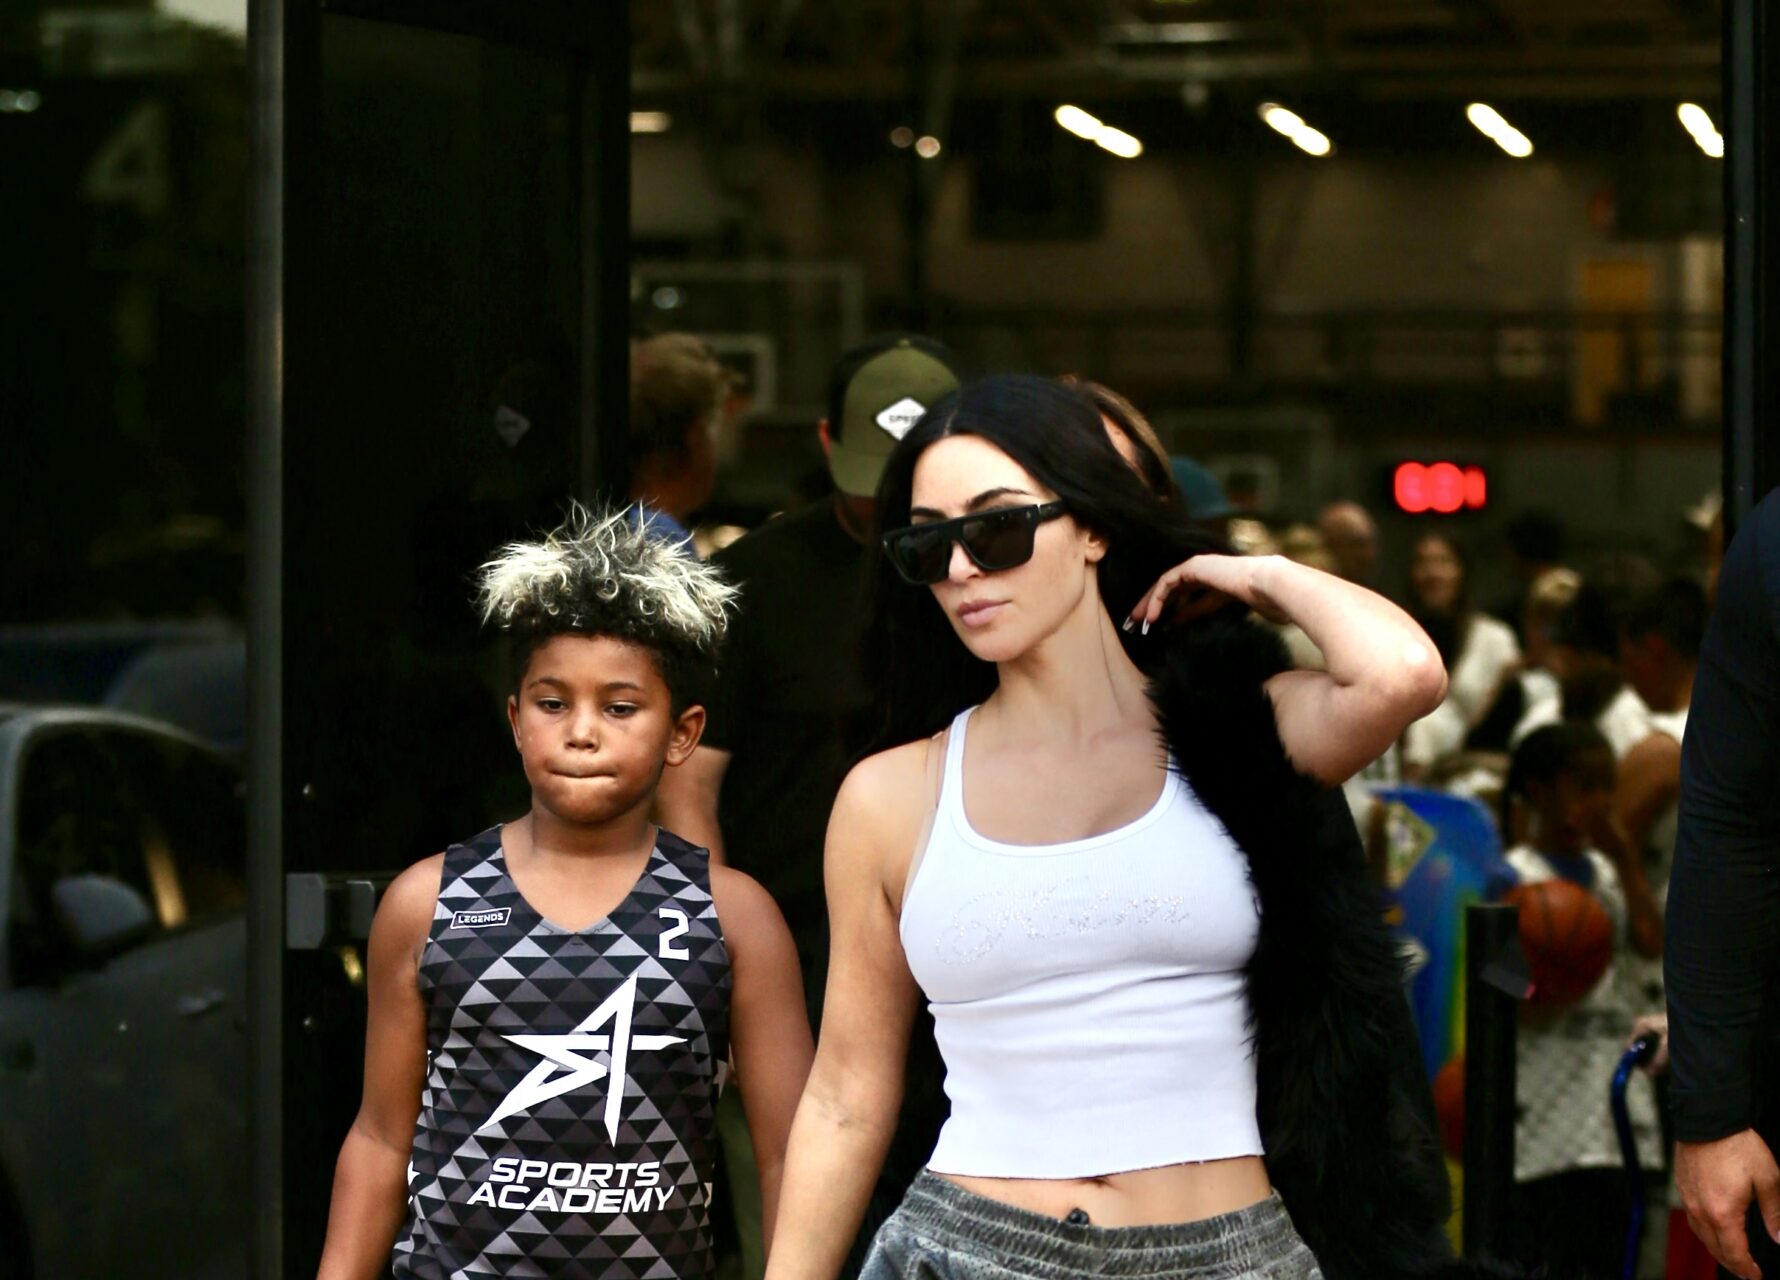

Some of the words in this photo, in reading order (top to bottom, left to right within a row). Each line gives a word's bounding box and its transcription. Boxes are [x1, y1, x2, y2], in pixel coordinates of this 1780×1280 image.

[458, 912, 504, 924] LEGENDS
[658, 907, 689, 961] 2
[488, 1158, 660, 1188] SPORTS
[466, 1181, 675, 1214] ACADEMY
